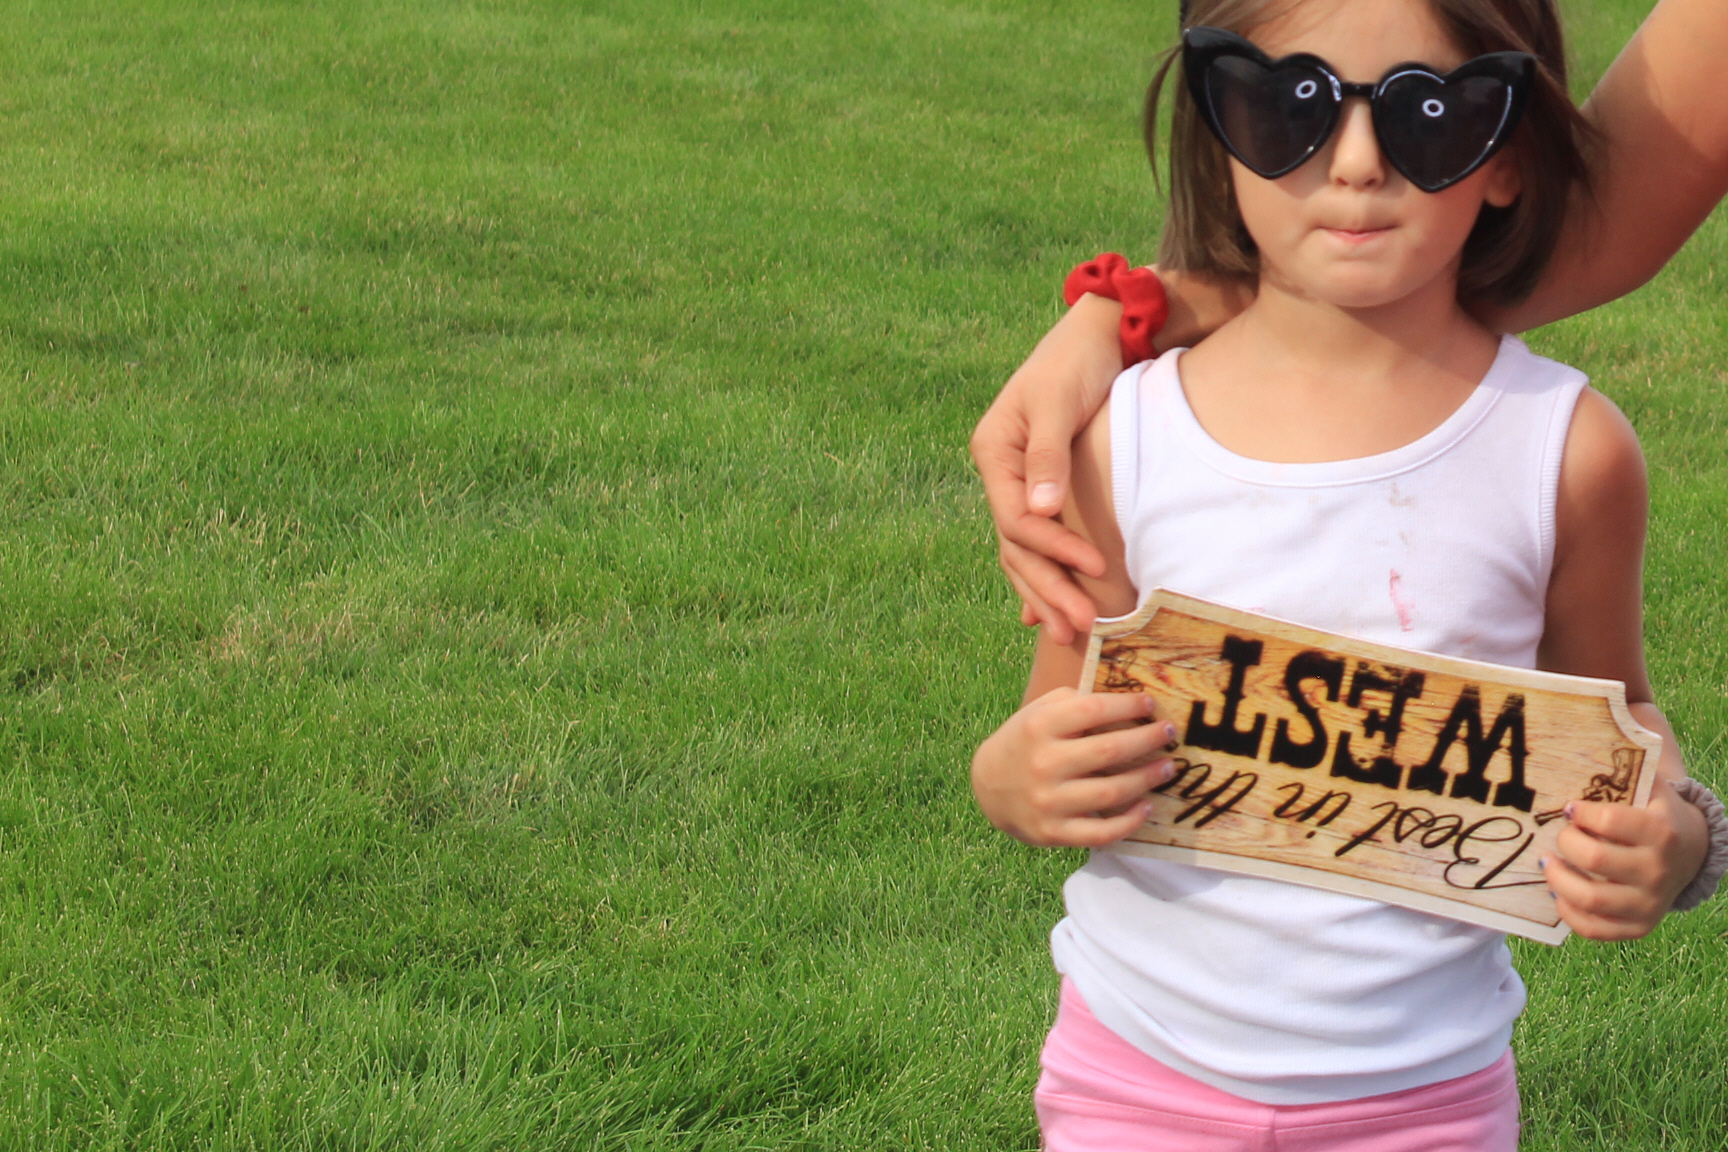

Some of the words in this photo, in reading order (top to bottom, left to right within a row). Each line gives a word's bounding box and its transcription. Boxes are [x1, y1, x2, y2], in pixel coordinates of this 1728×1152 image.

[1184, 634, 1537, 813] WEST
[1274, 780, 1354, 842] in
[1335, 800, 1548, 890] Best
